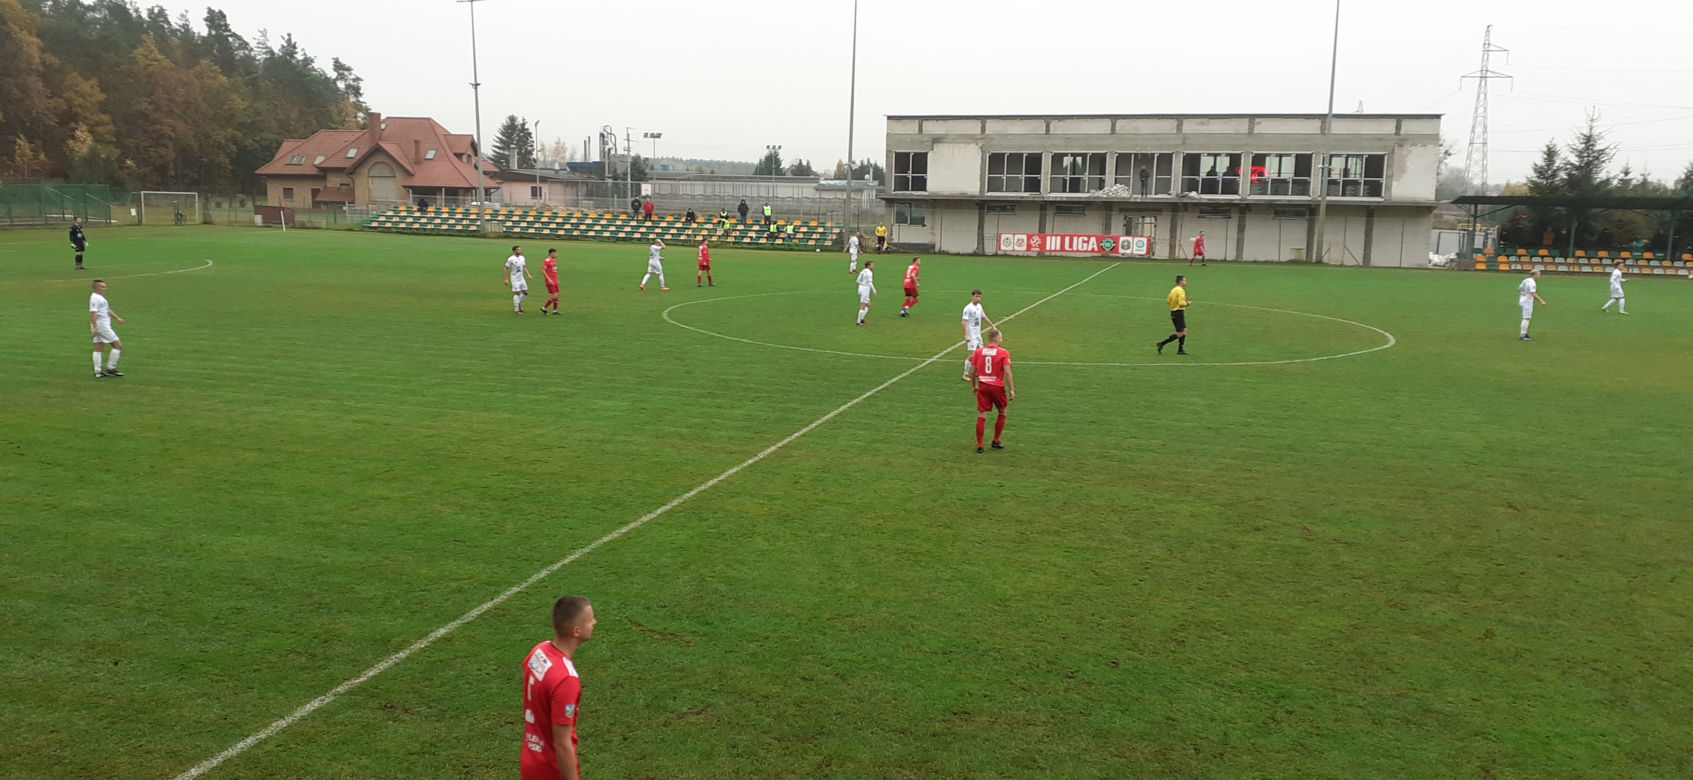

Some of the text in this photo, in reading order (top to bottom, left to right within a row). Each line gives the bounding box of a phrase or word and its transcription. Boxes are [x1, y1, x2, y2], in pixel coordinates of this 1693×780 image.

[1046, 236, 1098, 251] III LIGA
[985, 356, 992, 374] 8
